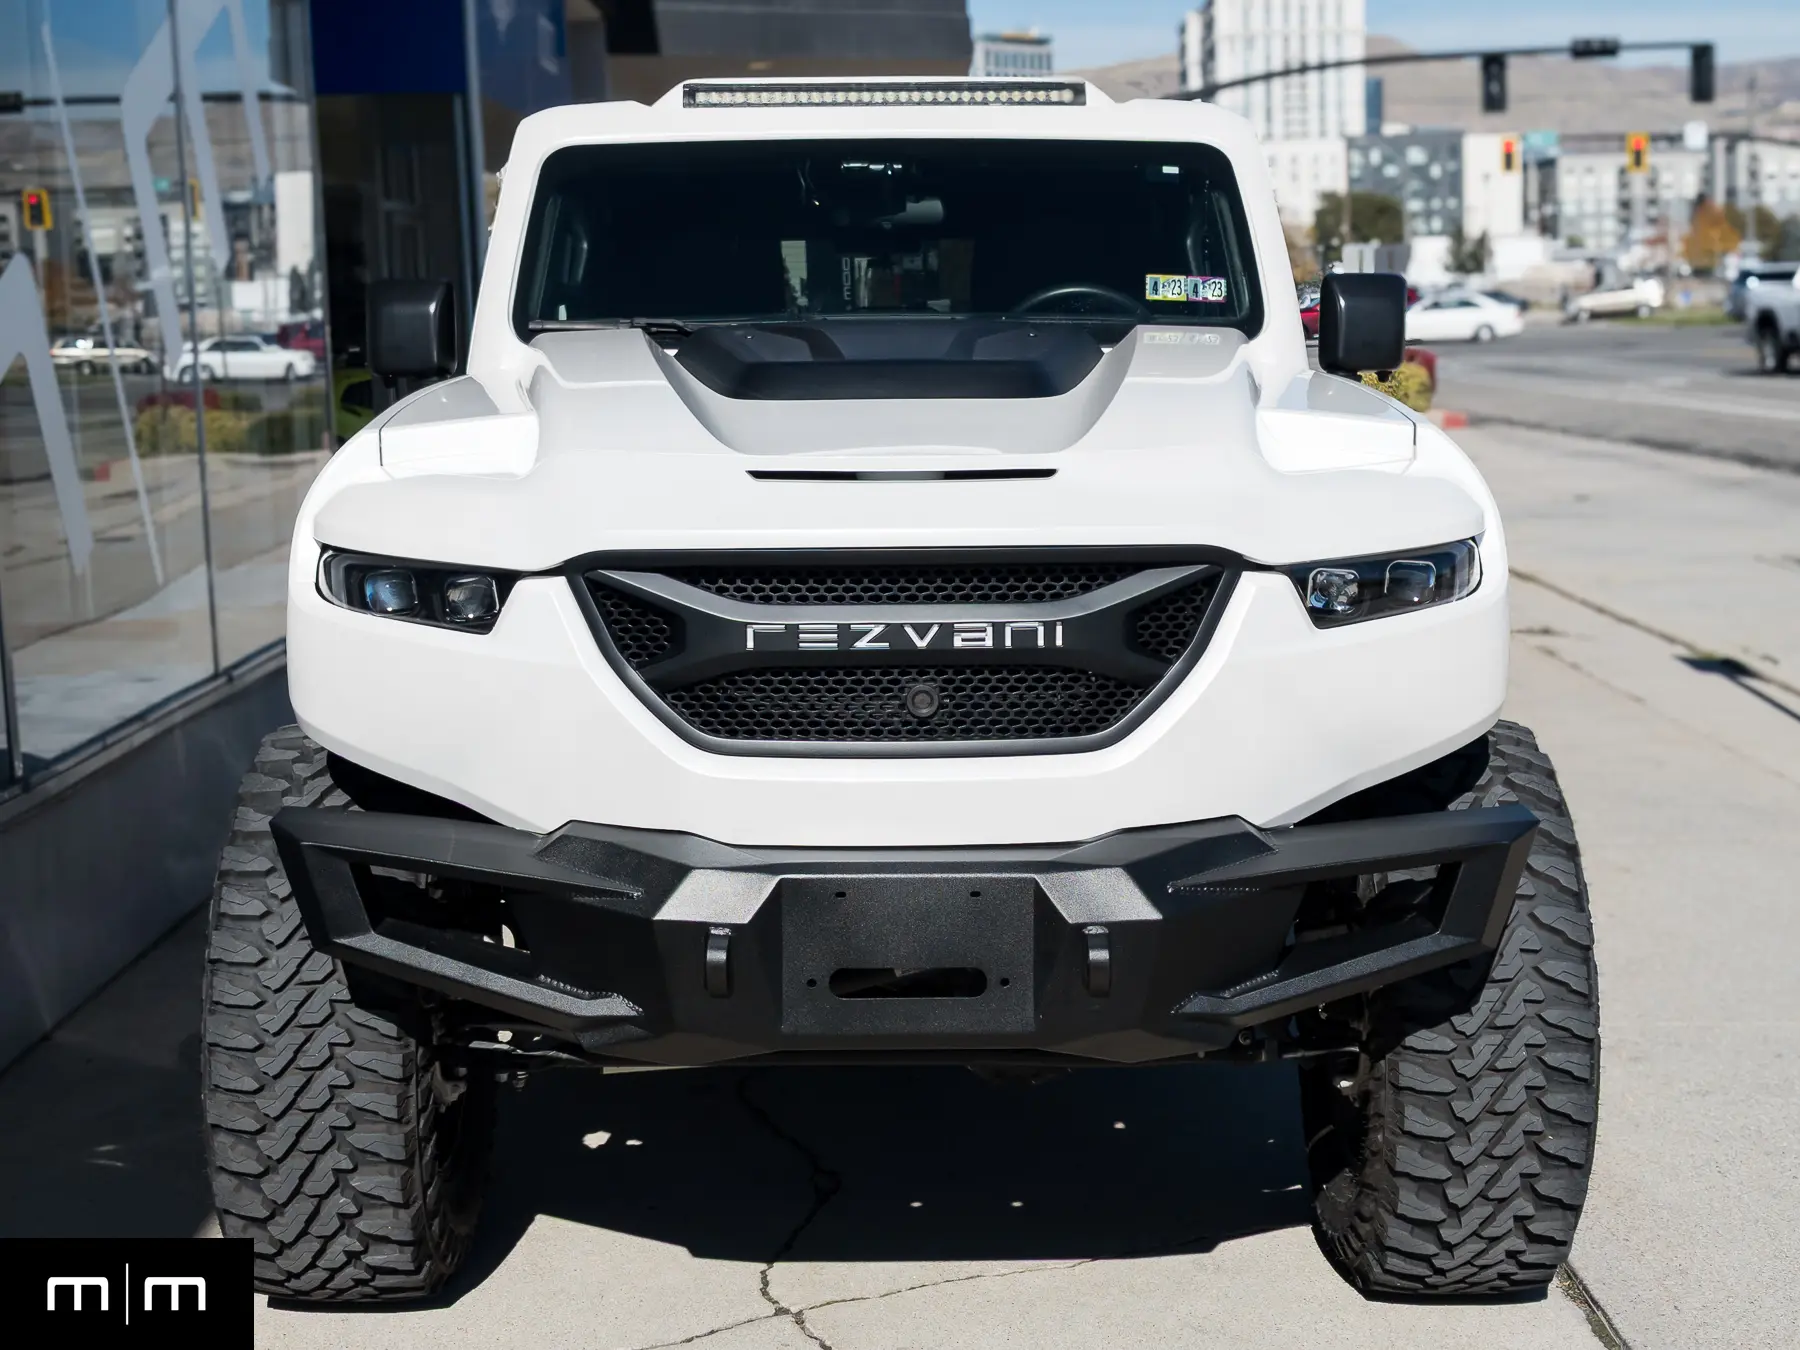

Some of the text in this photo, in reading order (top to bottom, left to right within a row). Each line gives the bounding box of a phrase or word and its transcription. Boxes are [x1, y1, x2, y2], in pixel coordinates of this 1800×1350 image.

[1152, 280, 1159, 296] 4
[1171, 279, 1183, 296] 23
[1192, 282, 1199, 298] 4
[1211, 280, 1223, 298] 23
